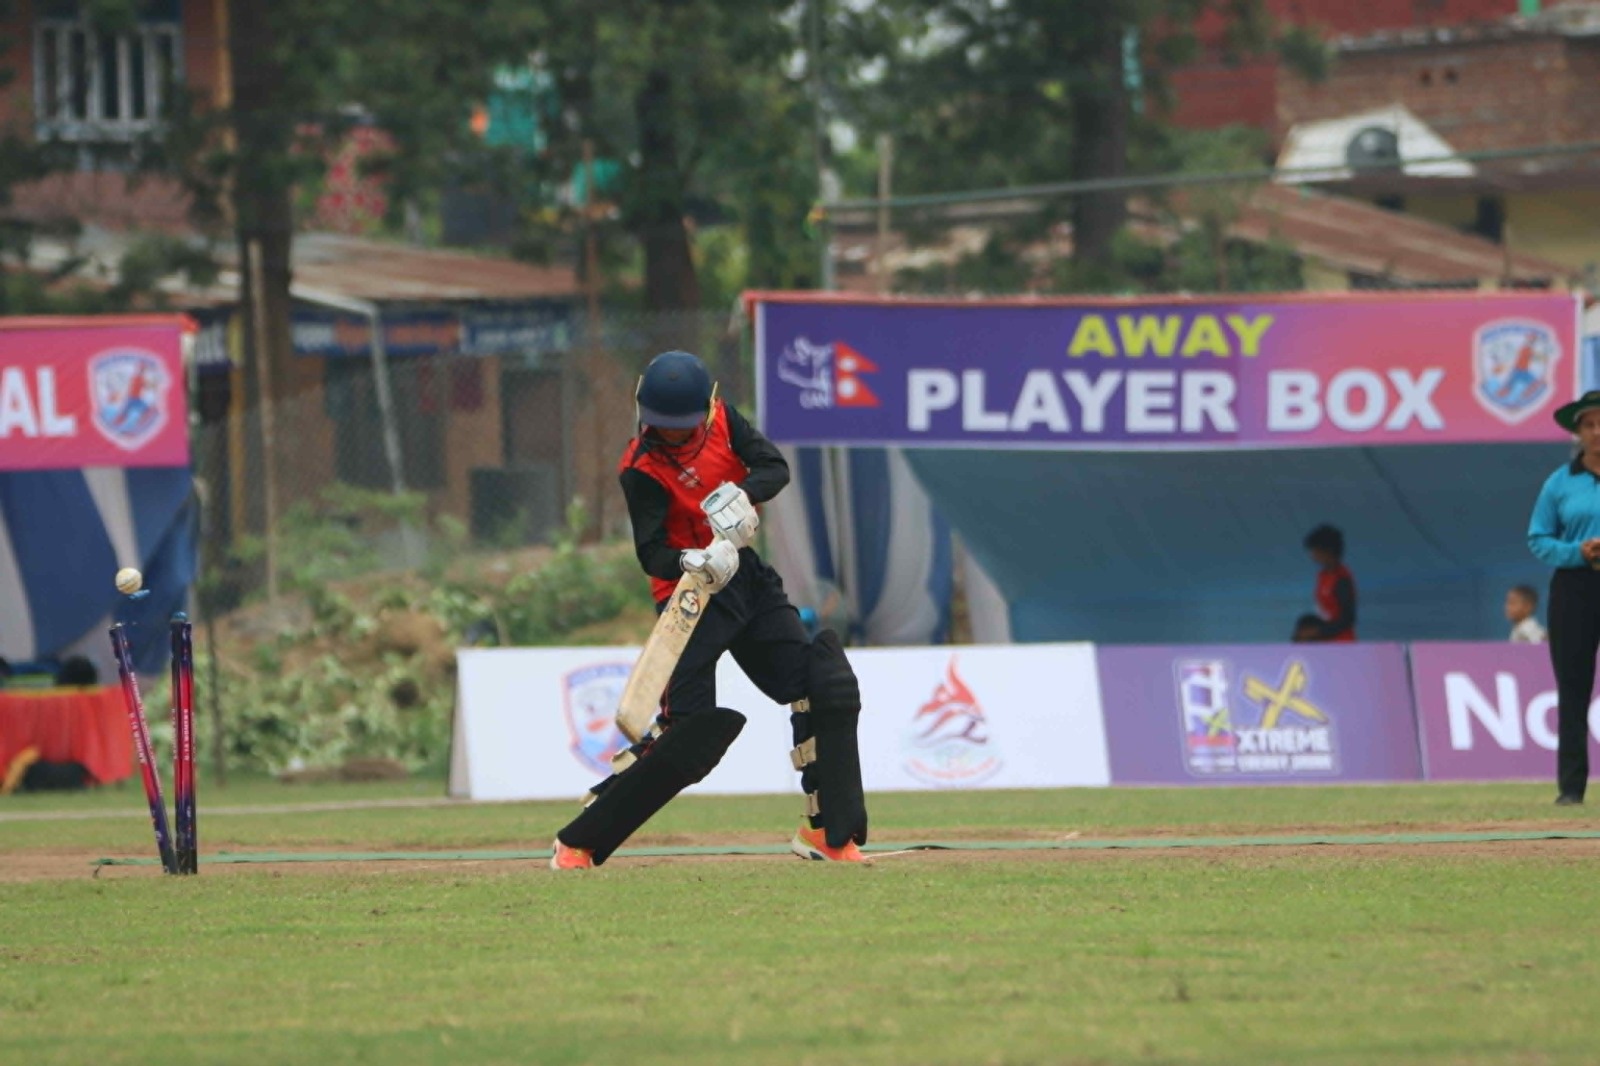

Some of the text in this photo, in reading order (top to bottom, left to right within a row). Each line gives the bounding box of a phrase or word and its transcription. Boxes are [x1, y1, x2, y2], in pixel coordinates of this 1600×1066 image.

[1067, 314, 1274, 358] AWAY
[907, 368, 1445, 433] PLAYER BOX
